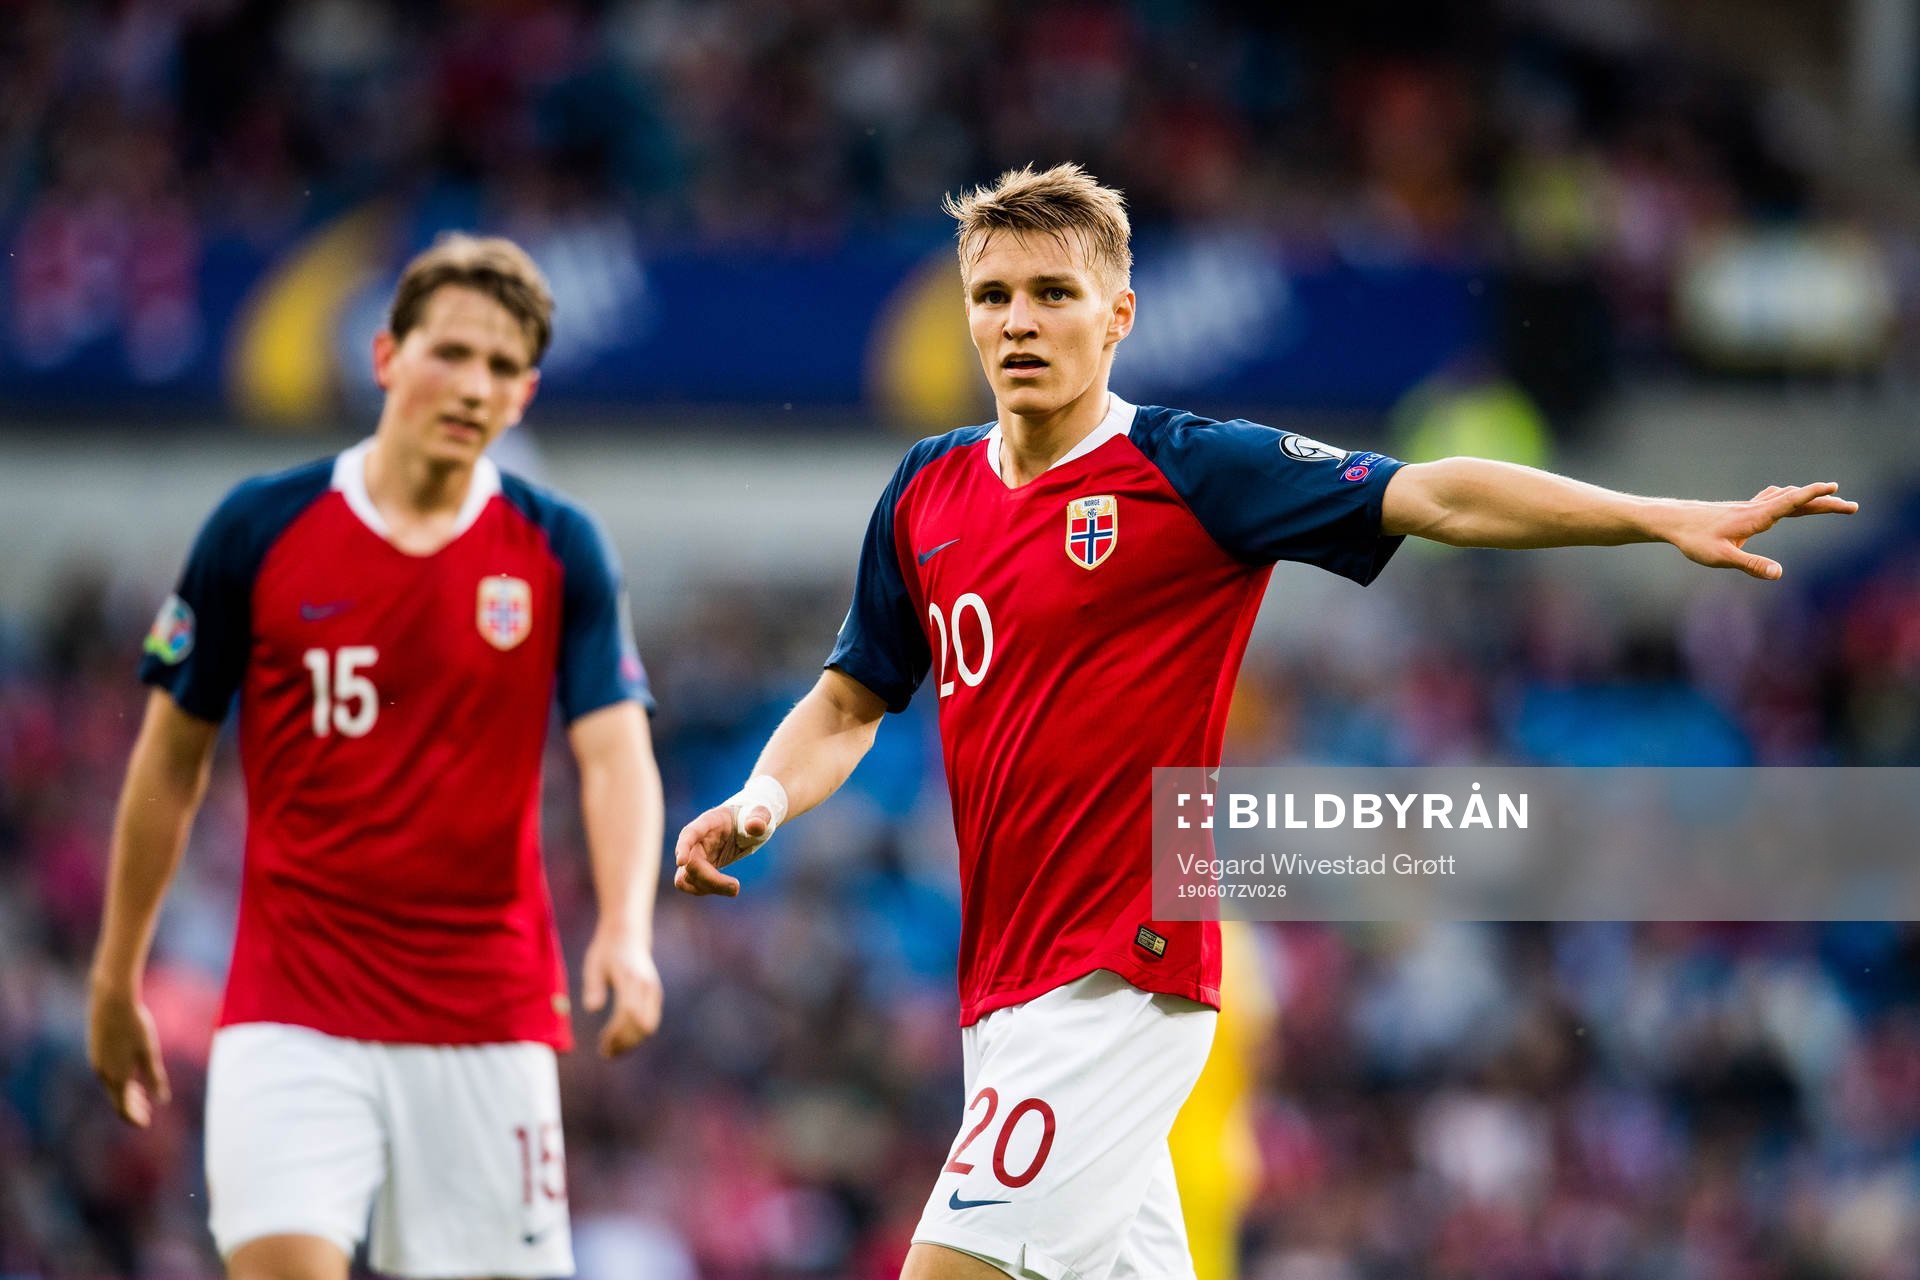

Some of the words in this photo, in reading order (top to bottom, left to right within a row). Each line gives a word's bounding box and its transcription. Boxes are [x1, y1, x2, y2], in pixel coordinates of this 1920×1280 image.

[303, 645, 379, 738] 15
[928, 592, 994, 699] 20
[943, 1086, 1056, 1189] 20
